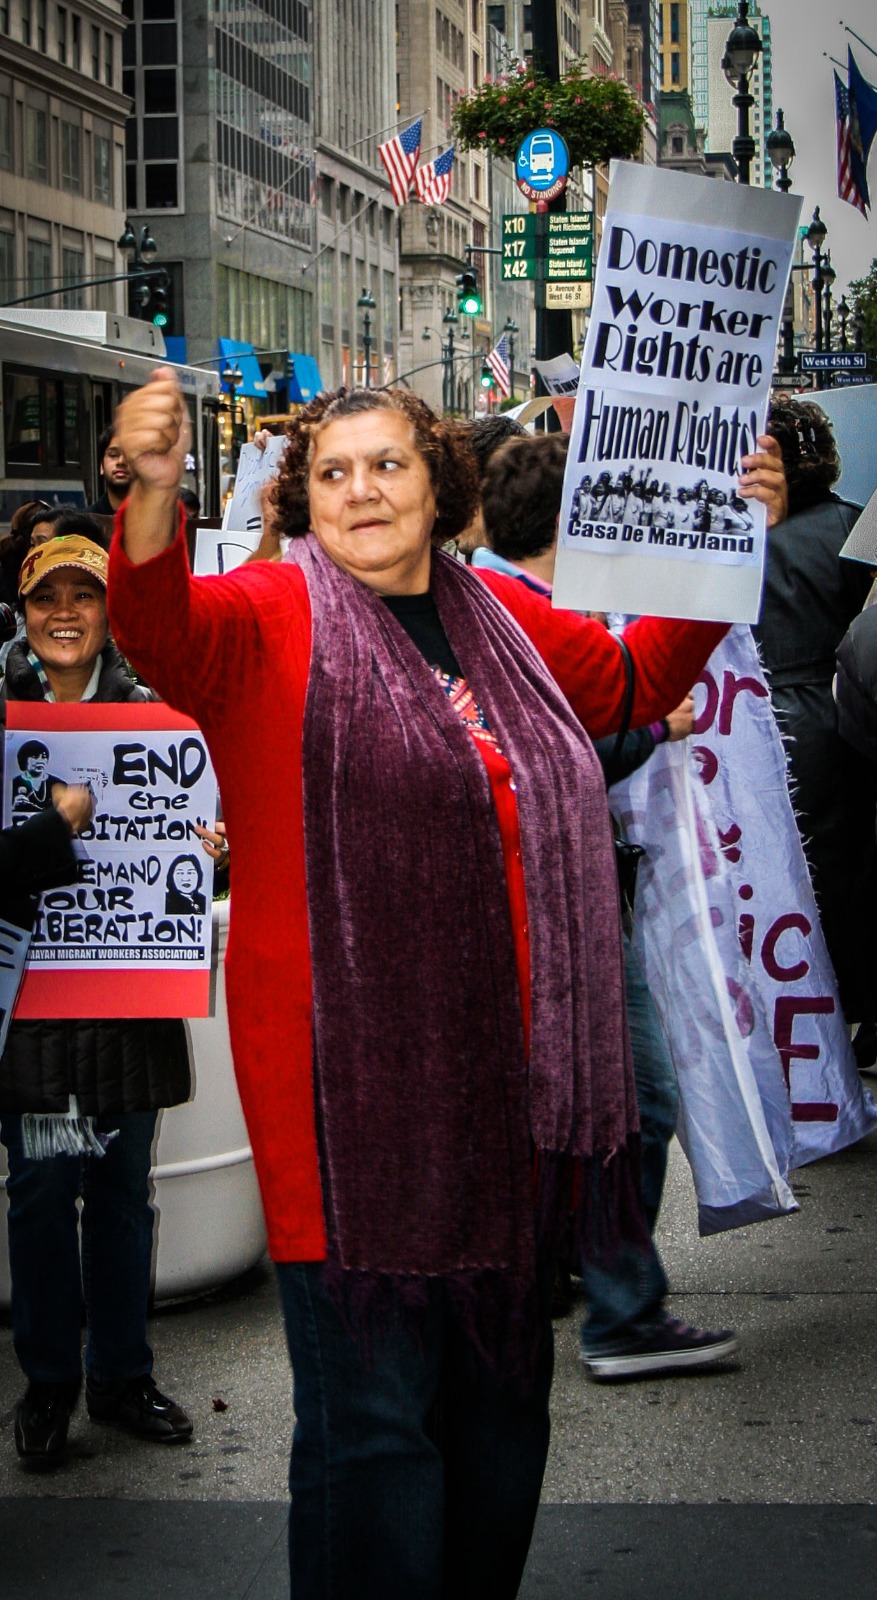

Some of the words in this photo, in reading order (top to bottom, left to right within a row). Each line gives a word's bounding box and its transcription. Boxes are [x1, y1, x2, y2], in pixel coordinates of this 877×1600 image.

[520, 182, 530, 195] NO
[530, 180, 563, 199] STANDING
[549, 215, 568, 224] Staten
[549, 224, 562, 232] Port
[562, 223, 590, 231] Richmond
[548, 246, 575, 255] Huguenot
[549, 238, 568, 247] Staten
[548, 260, 565, 268] Staten
[606, 226, 778, 295] Domestic
[570, 268, 587, 276] Harbor
[574, 292, 581, 300] St
[605, 285, 773, 339] Worker
[591, 322, 714, 383] Rights
[715, 351, 763, 388] are
[804, 356, 829, 366] West
[830, 356, 851, 366] 45th
[853, 355, 864, 366] St
[577, 389, 670, 463] Human
[670, 400, 757, 478] Rights!
[567, 519, 617, 541] Casa
[621, 525, 643, 542] De
[648, 529, 754, 553] Maryland
[112, 737, 207, 788] END
[128, 791, 190, 810] the
[77, 855, 162, 887] EMAND
[44, 886, 134, 912] OUR
[31, 911, 203, 944] IBERATION!
[28, 949, 56, 959] MAYAN
[57, 949, 97, 959] MIGRANT
[98, 949, 141, 959] WORKERS
[141, 948, 199, 960] ASSOCIATION
